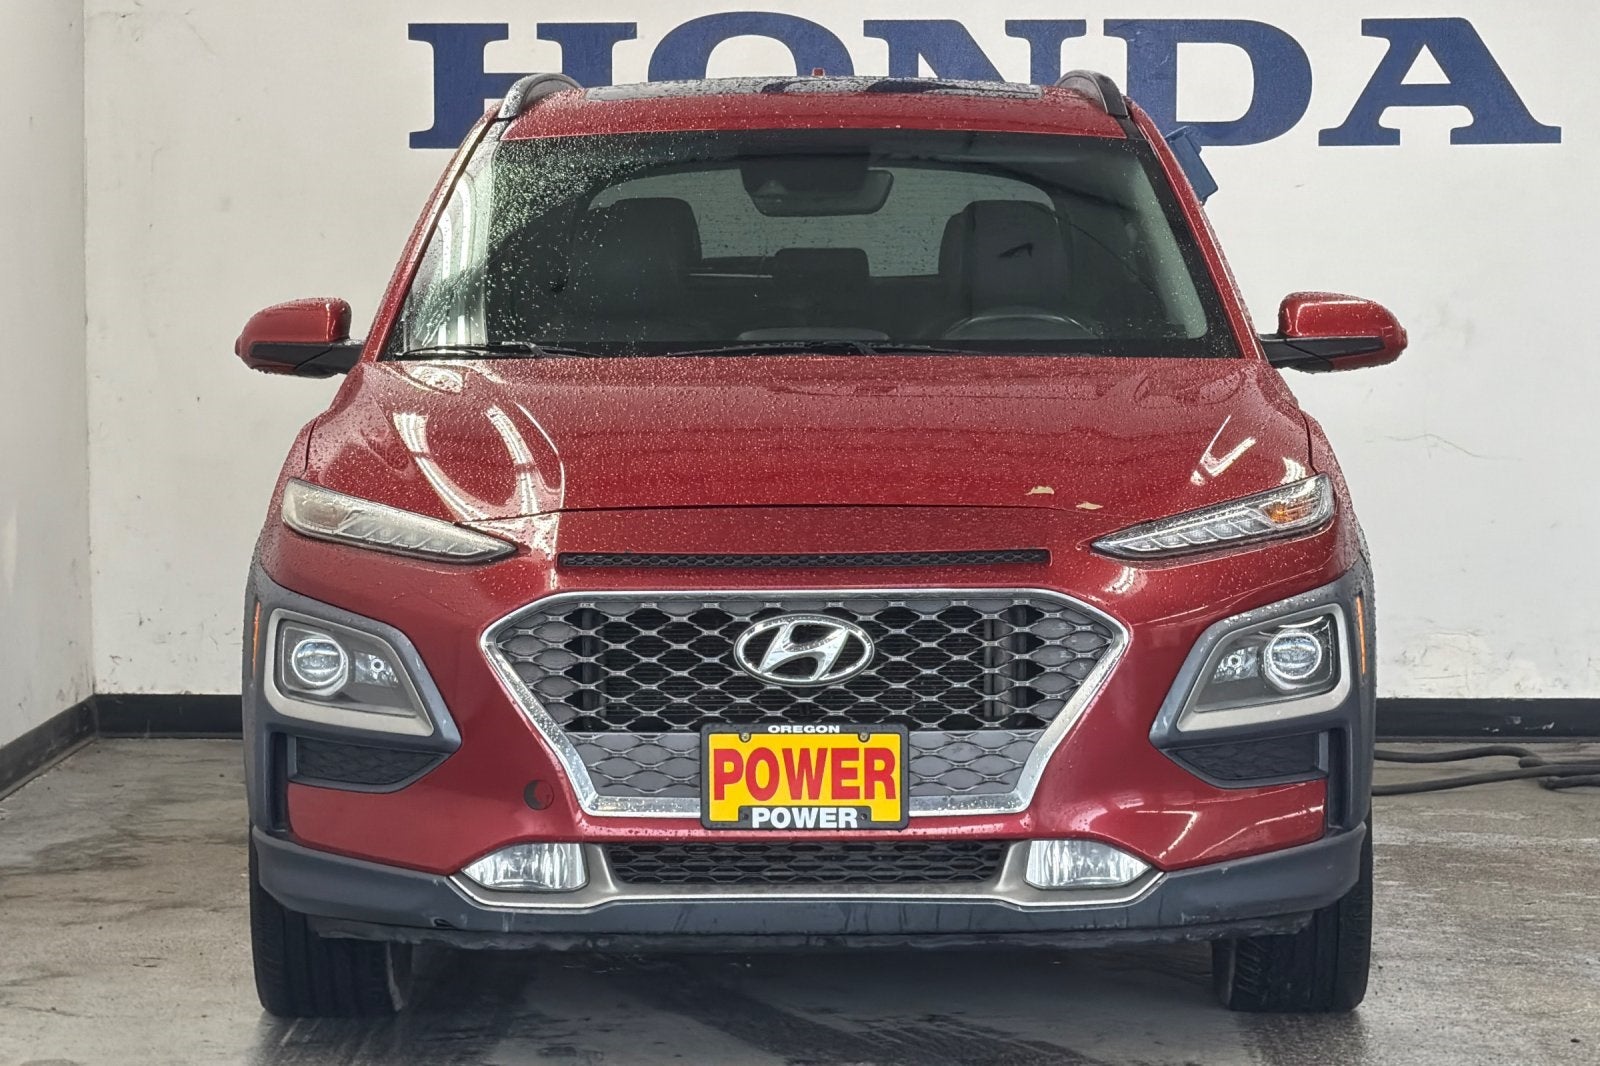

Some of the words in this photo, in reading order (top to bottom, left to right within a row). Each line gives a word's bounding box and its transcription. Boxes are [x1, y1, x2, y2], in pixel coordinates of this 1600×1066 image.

[767, 725, 840, 734] OREGON
[713, 747, 896, 801] POWER
[752, 807, 858, 829] POWER
